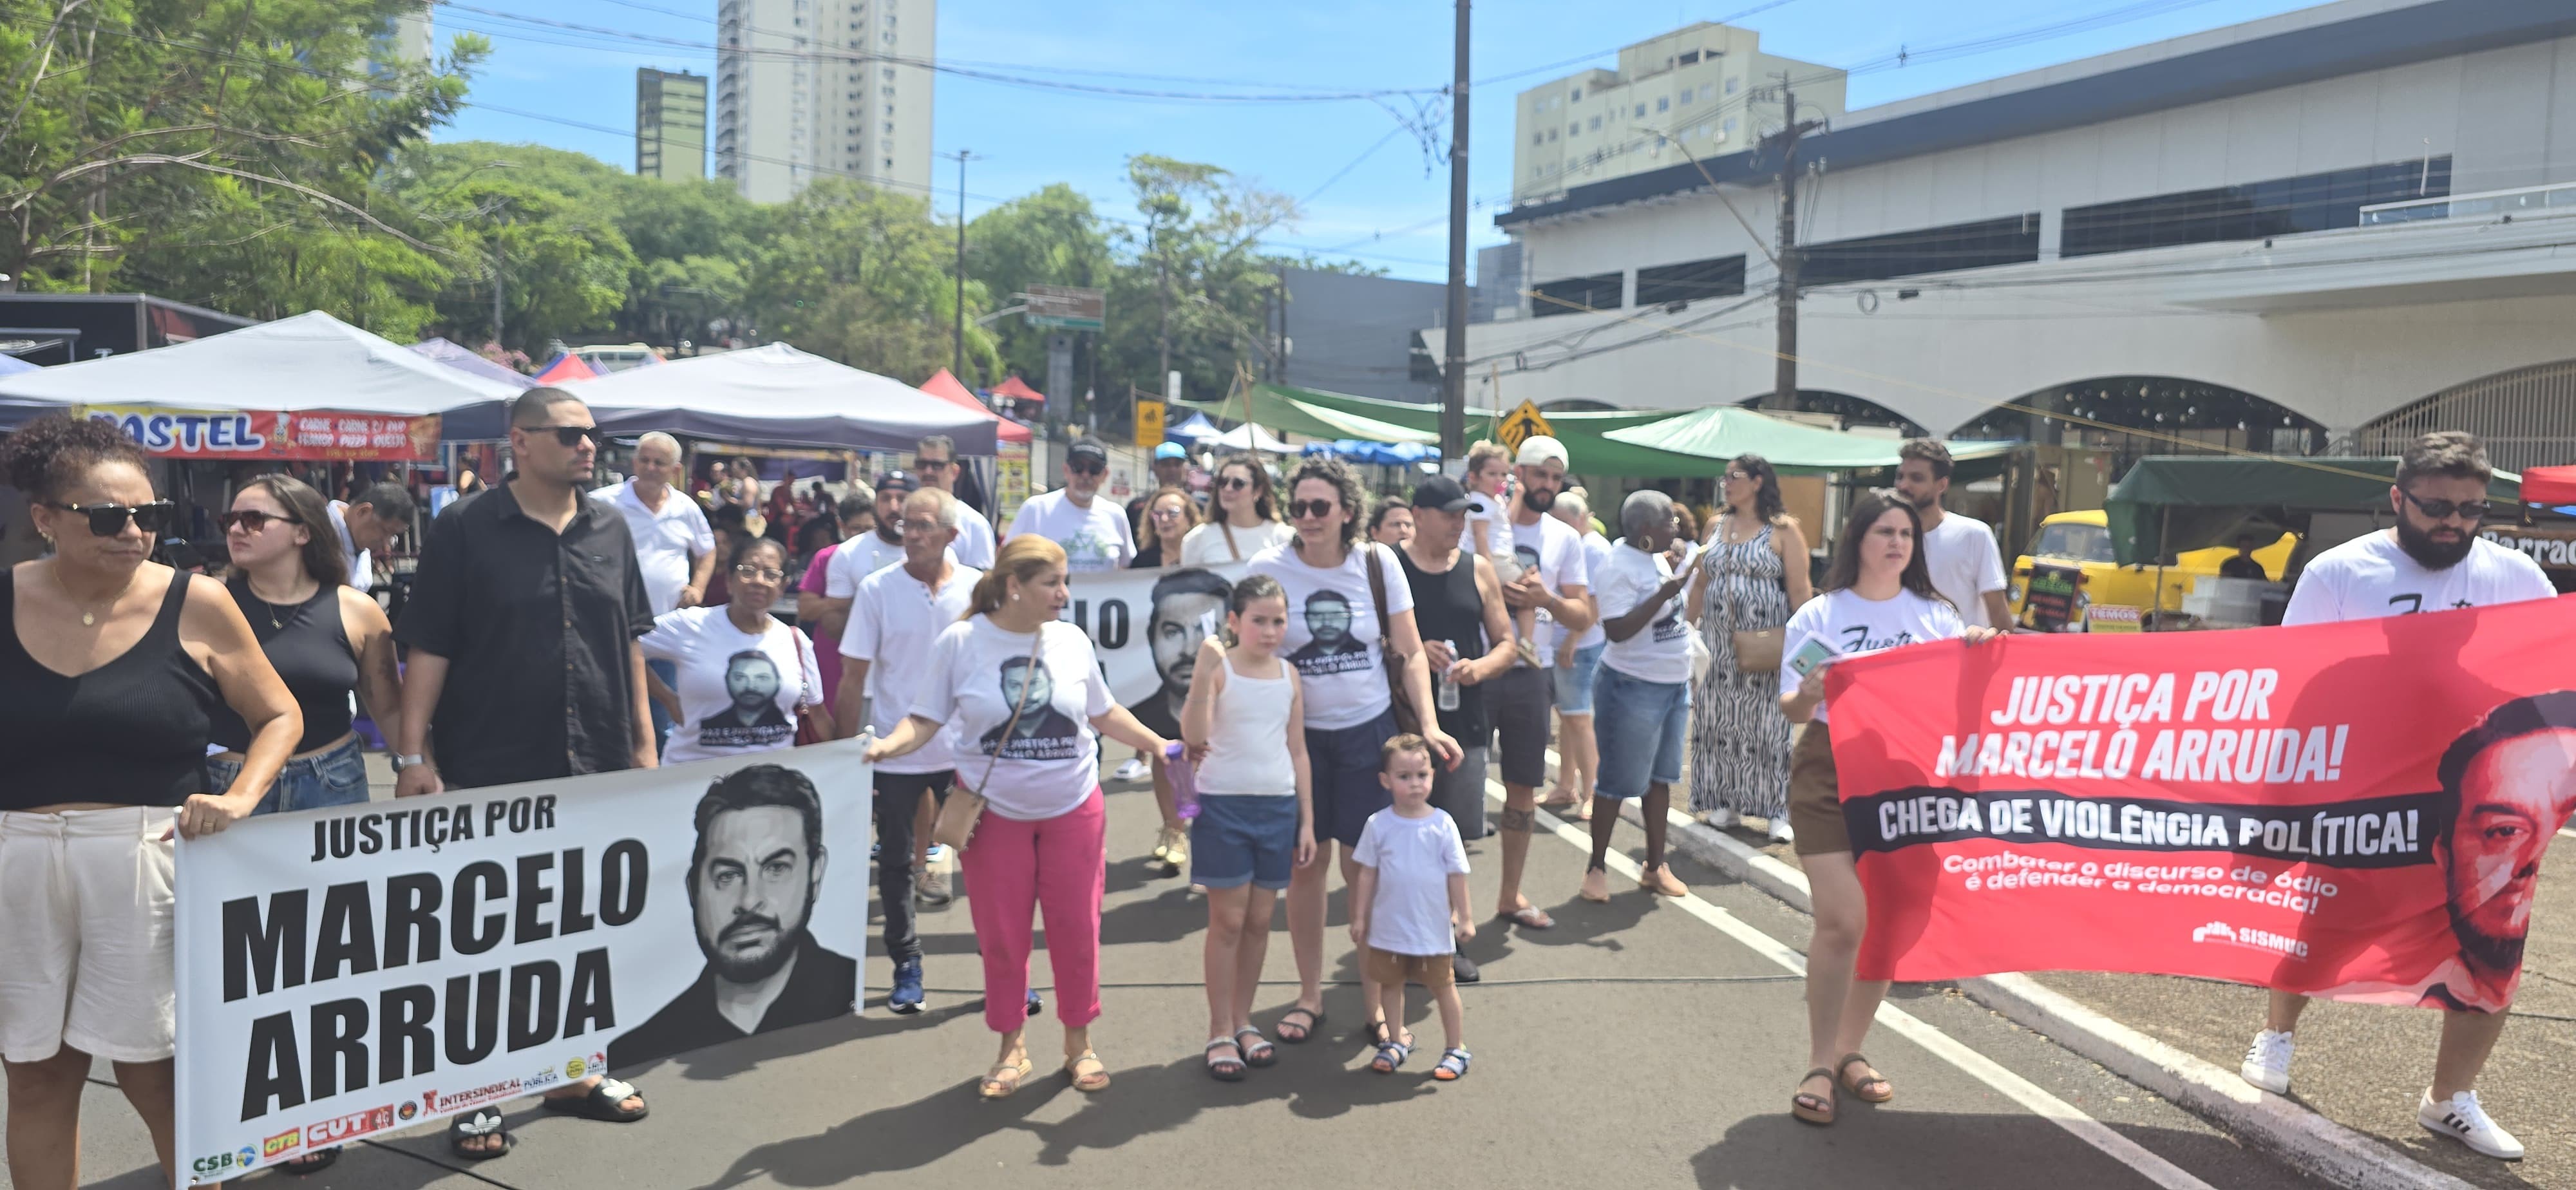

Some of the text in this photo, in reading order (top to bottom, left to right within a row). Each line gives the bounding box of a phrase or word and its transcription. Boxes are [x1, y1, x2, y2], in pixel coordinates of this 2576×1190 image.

[2091, 607, 2138, 620] TEMOS
[1990, 668, 2278, 728] JUSTIÇA POR
[1934, 724, 2349, 783] MARCELO ARRUDA!
[310, 794, 557, 863] JUSTIÇA POR
[1878, 795, 2419, 856] CHEGA DE VIOLÊNCIA POLÍTICA!
[1943, 851, 2338, 898] Combater o discurso de ódio
[1965, 868, 2318, 915] é defender a democracia!
[222, 837, 649, 1003] MARCELO
[2239, 927, 2308, 958] SISMUC
[241, 946, 616, 1123] ARRUDA
[440, 1077, 522, 1107] INTERSINDICAL
[308, 1113, 366, 1142] CUT
[193, 1152, 232, 1173] CSB
